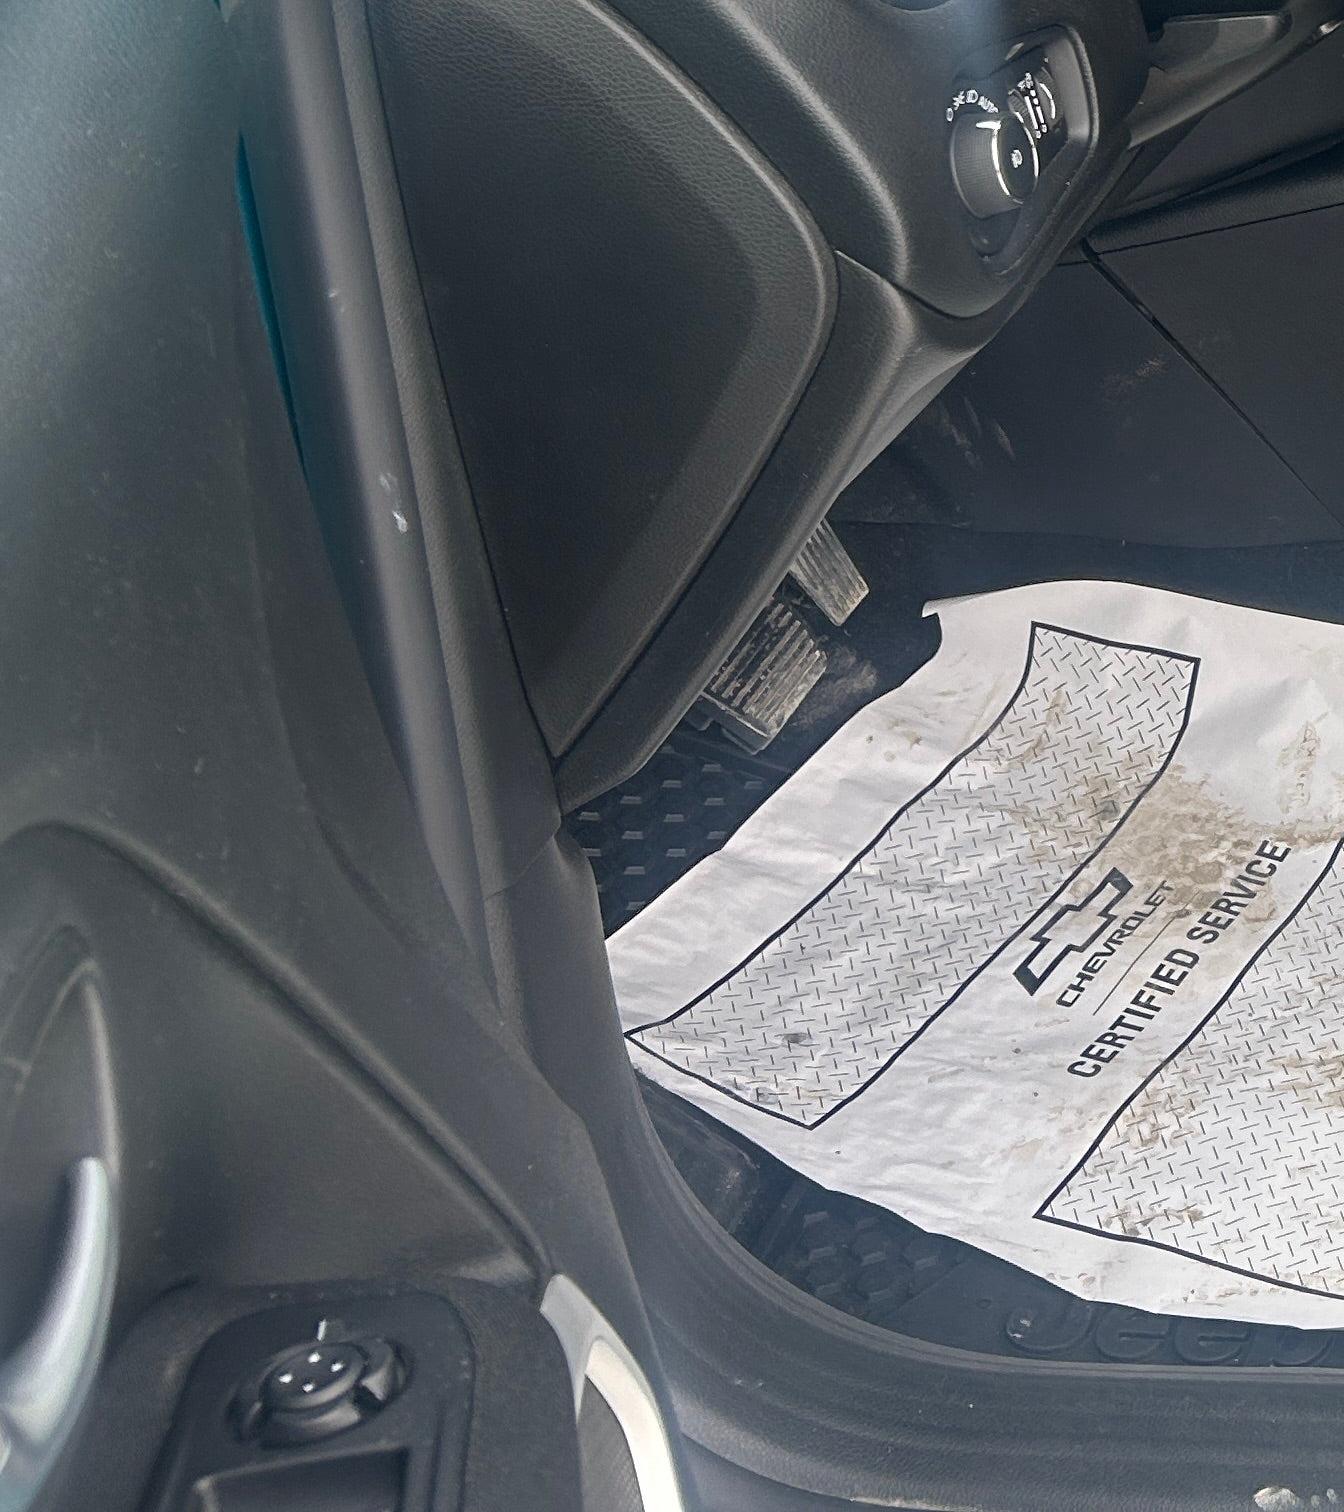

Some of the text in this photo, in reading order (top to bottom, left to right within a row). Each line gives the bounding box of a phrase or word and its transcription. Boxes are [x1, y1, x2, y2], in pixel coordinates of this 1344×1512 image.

[1056, 879, 1173, 1007] CHEVROLET
[1067, 840, 1291, 1078] CERTIFIED SERVICE
